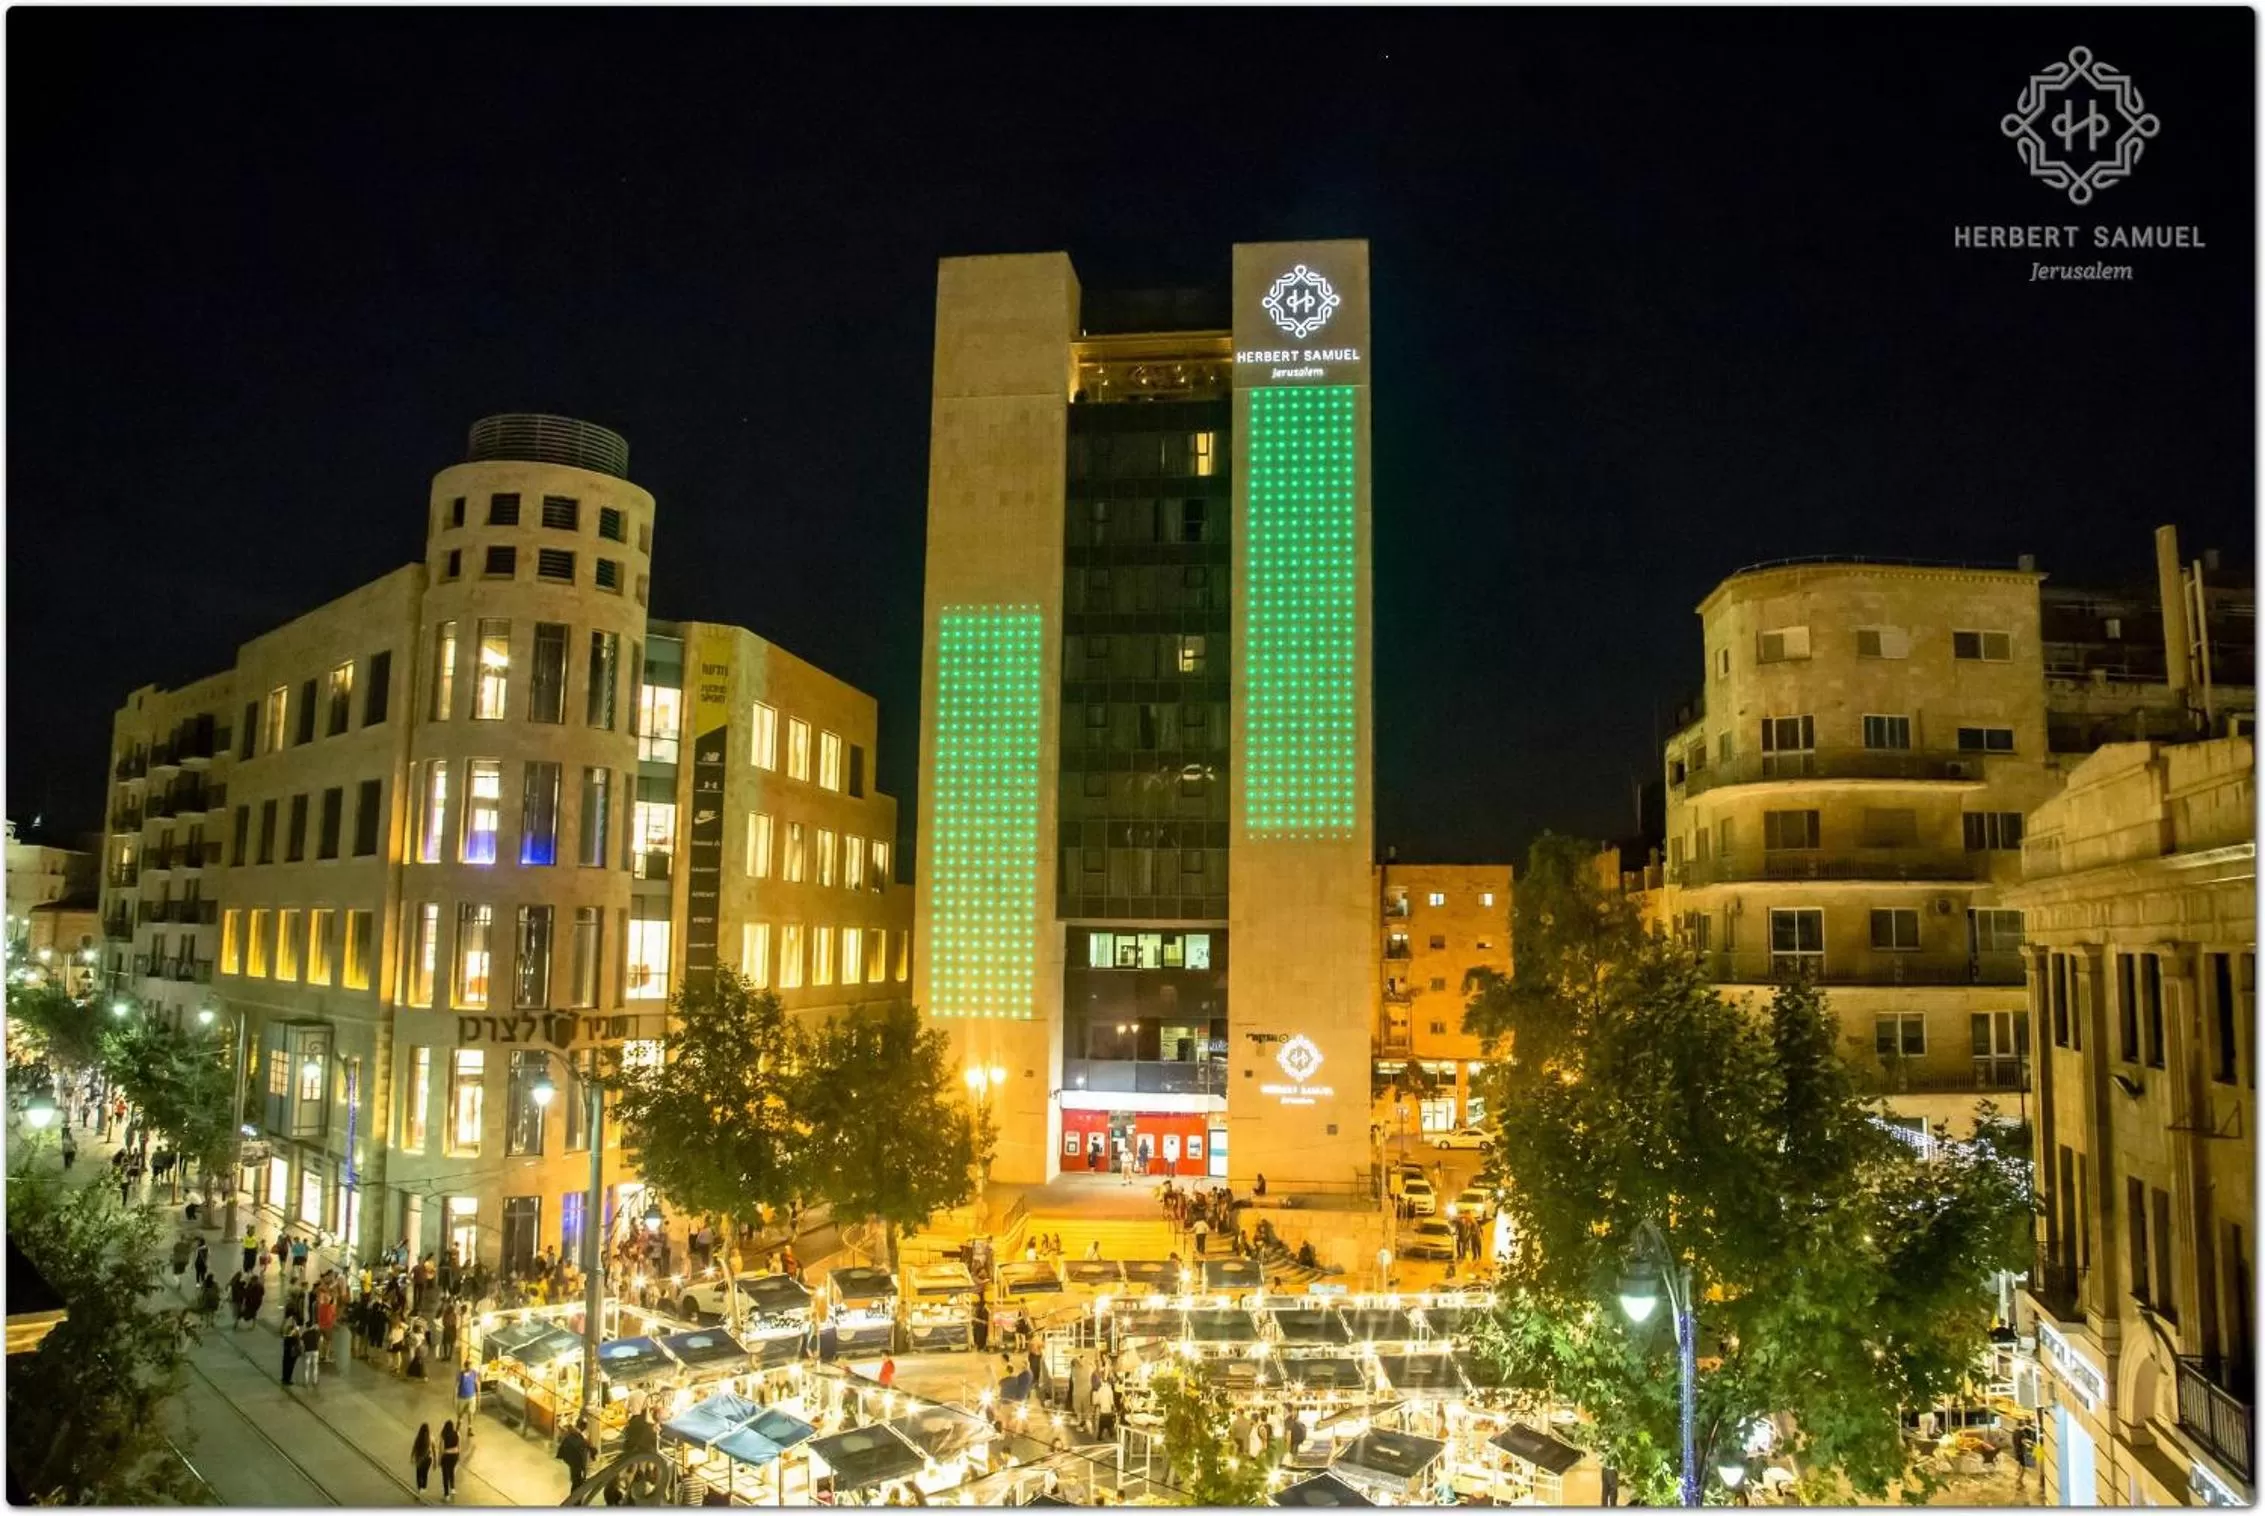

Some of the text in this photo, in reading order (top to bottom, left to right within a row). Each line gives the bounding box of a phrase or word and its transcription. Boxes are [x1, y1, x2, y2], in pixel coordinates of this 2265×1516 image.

[1237, 349, 1361, 363] HERBERT SAMUEL
[1271, 367, 1324, 379] Jerusalem
[458, 1012, 537, 1047] לצרכן
